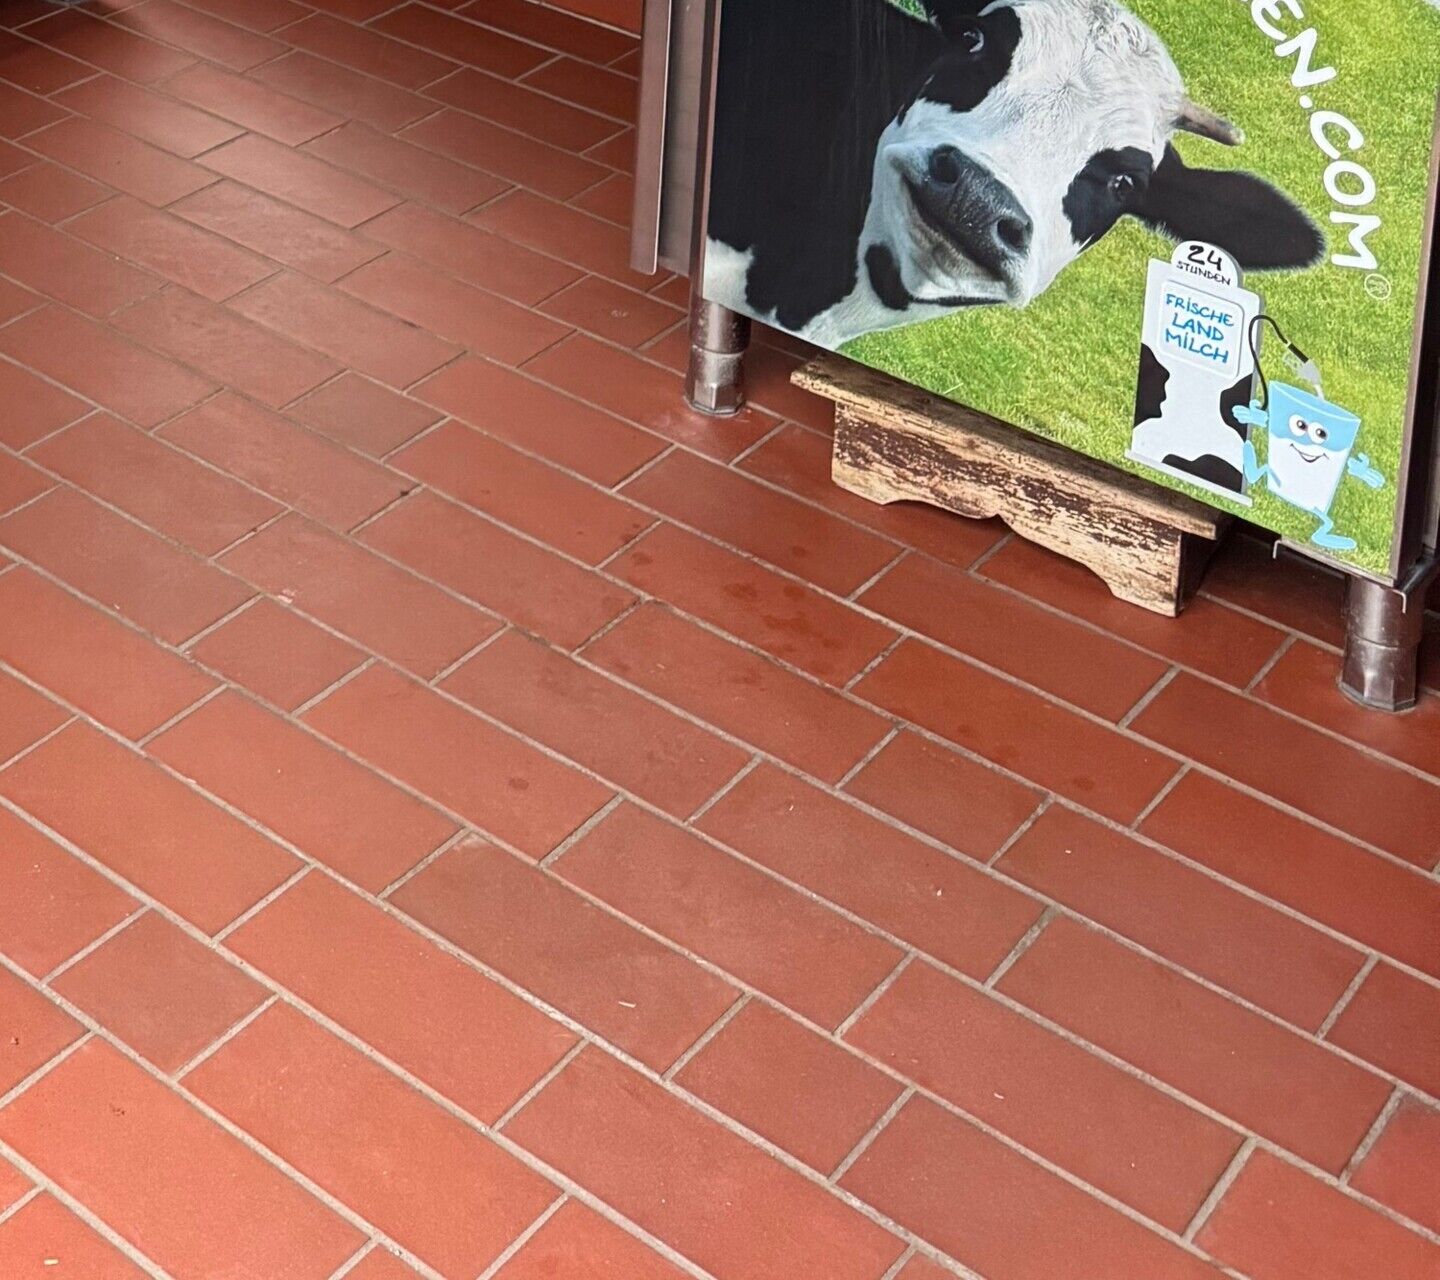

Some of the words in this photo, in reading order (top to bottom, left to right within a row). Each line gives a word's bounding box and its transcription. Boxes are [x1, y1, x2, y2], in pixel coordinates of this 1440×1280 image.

[1187, 244, 1222, 271] 24
[1175, 260, 1231, 286] STUNDEN
[1172, 313, 1225, 342] LAND
